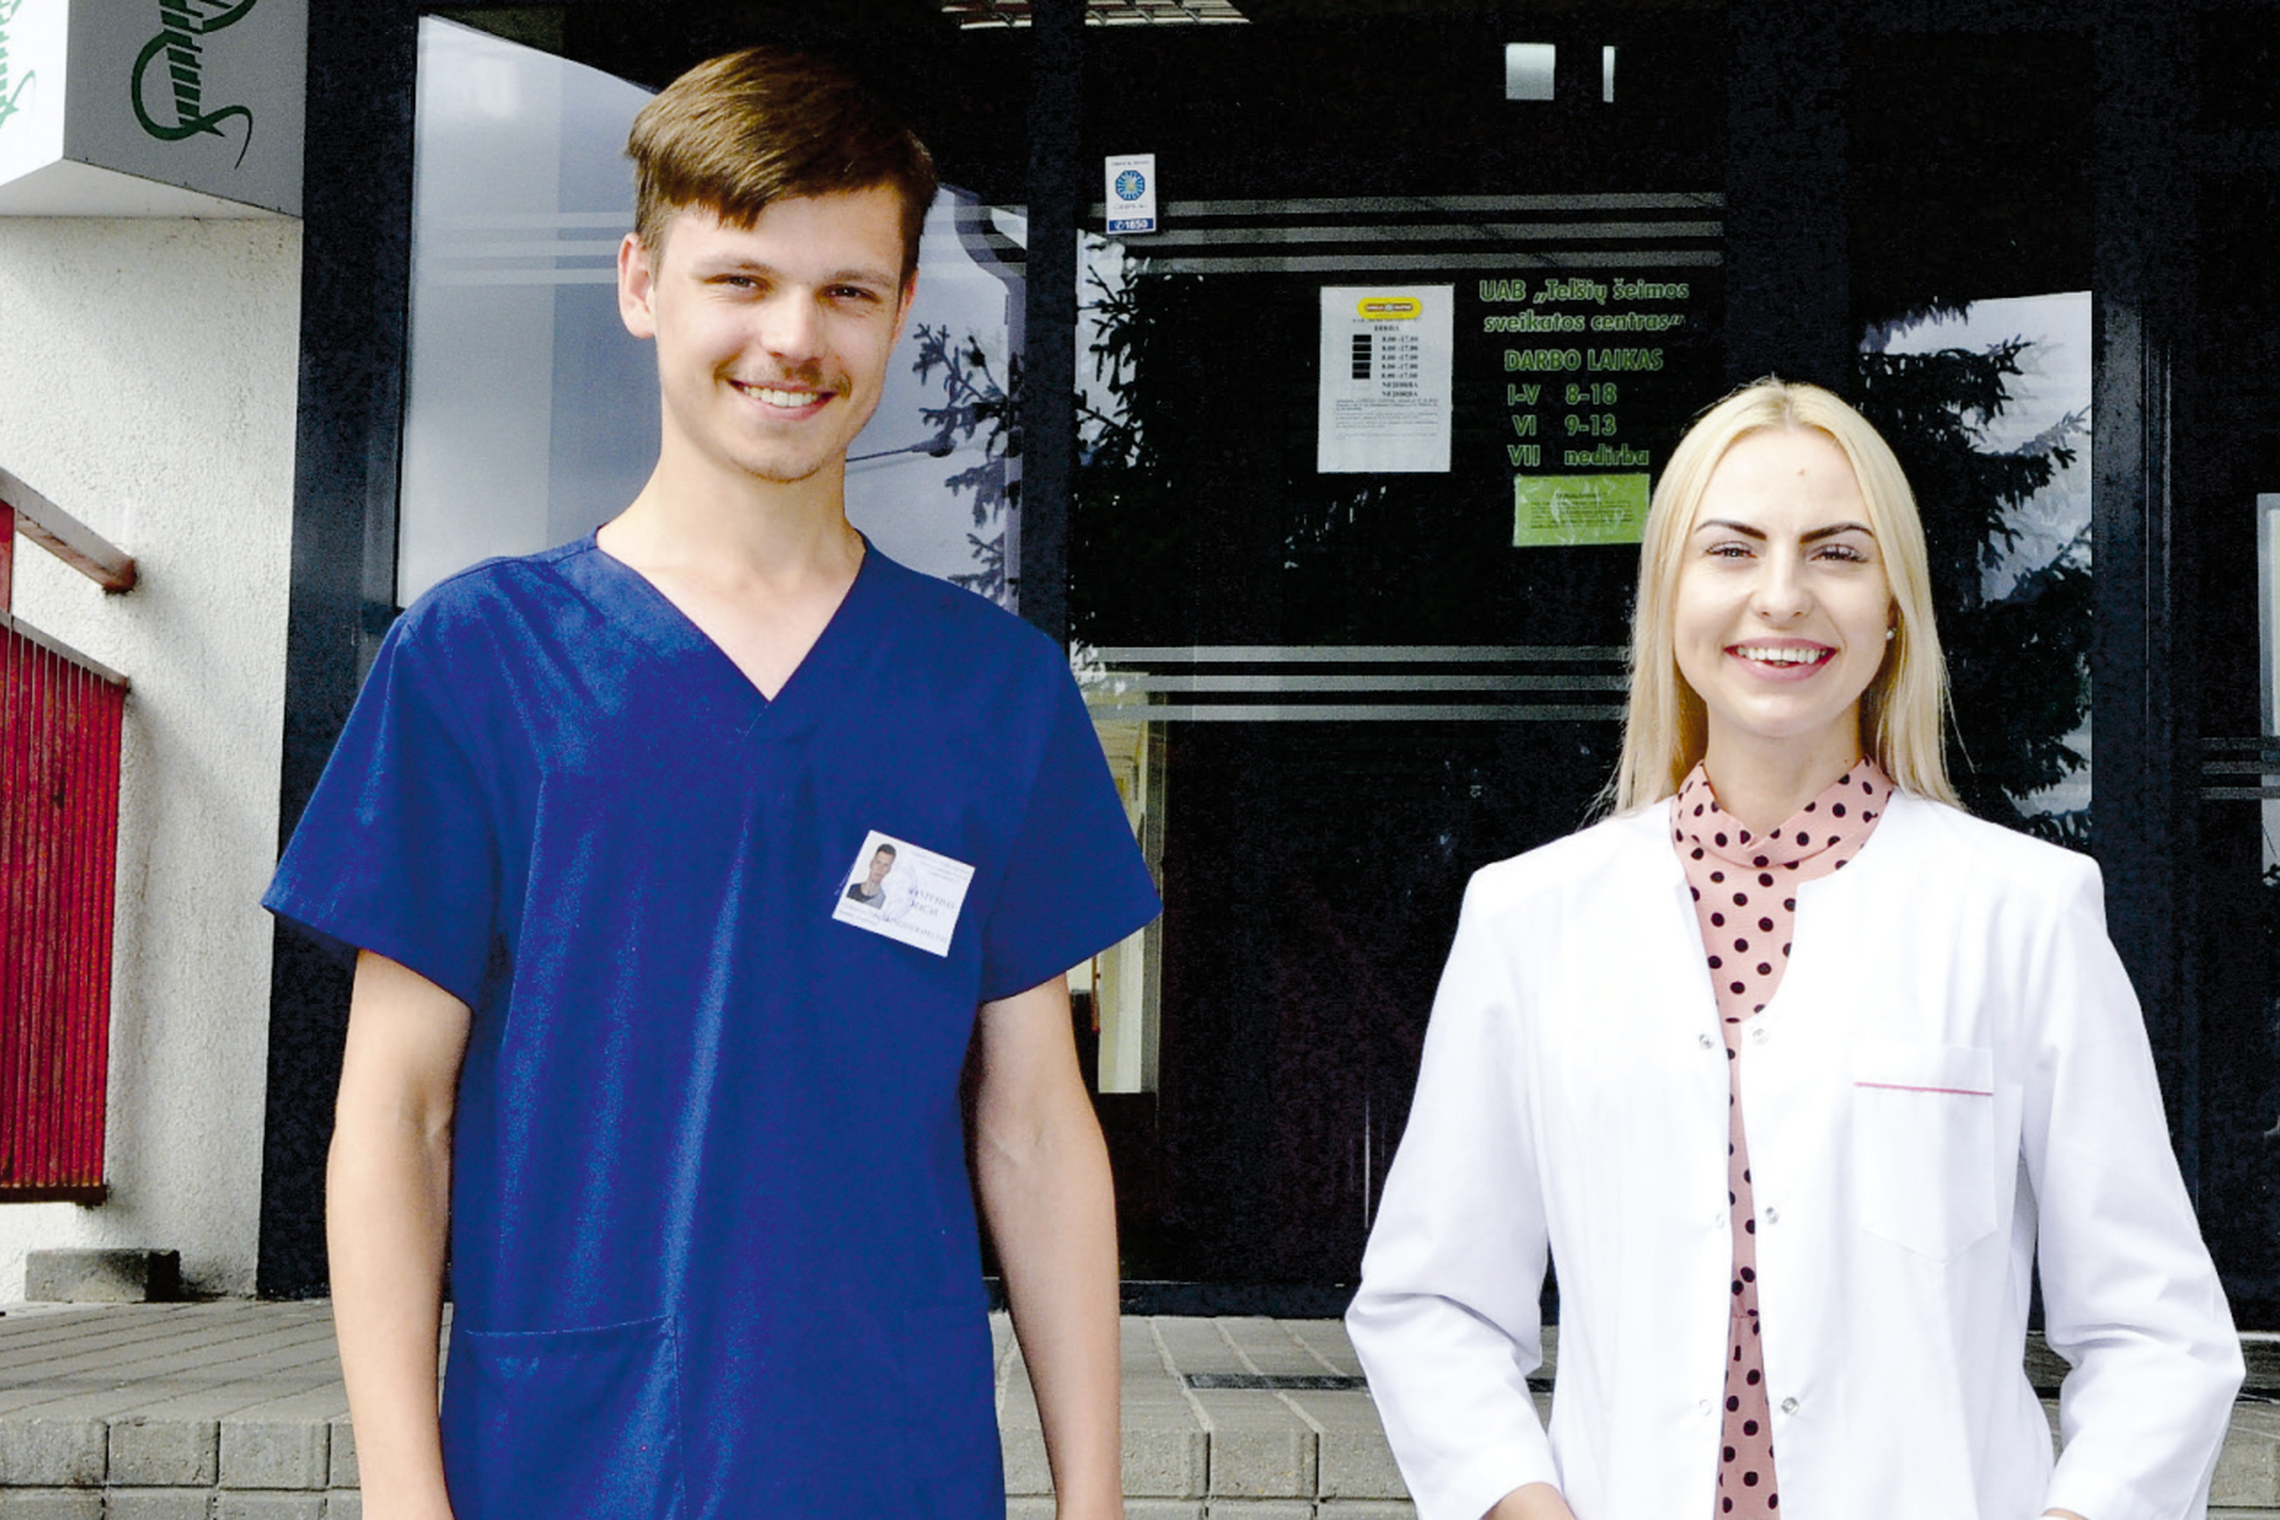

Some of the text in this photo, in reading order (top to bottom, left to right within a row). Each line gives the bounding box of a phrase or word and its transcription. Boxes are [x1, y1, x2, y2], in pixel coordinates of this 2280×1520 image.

[1479, 279, 1526, 301] UAB
[1612, 278, 1690, 300] šeimos
[1483, 309, 1585, 332] sveikatos
[1504, 349, 1664, 371] DARBO LAIKAS
[1507, 382, 1617, 406] I-V 8-18
[1512, 413, 1617, 436] VI 9-13
[1507, 443, 1649, 467] VII nedirba
